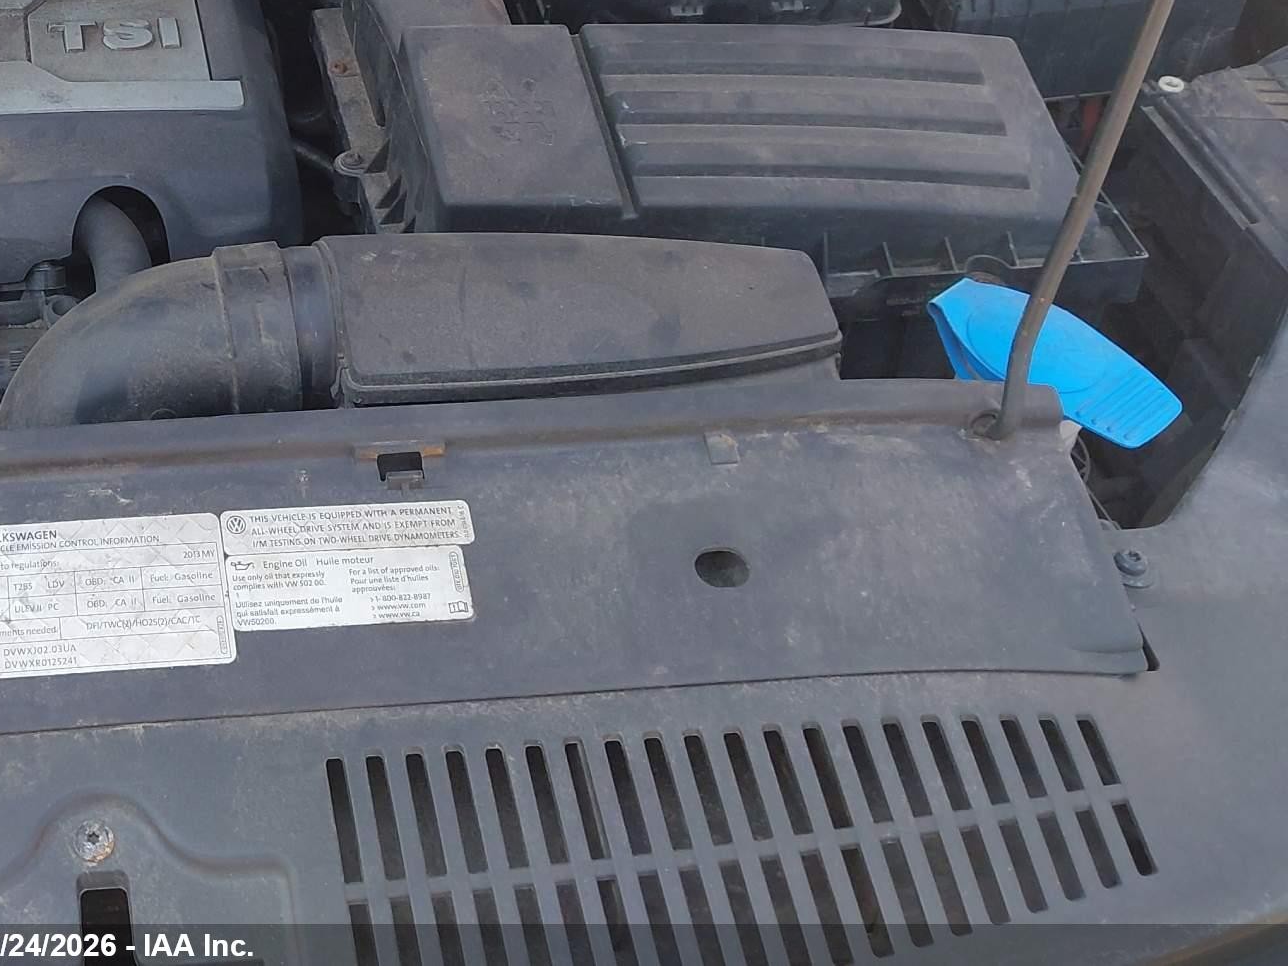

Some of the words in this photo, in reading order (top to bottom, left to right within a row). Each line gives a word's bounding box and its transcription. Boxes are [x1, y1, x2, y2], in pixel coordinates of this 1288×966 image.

[46, 17, 182, 54] TSI
[250, 514, 269, 523] THIS
[272, 513, 306, 522] VEHICLE
[309, 512, 316, 520] IS
[320, 510, 362, 520] EQUIPPED
[364, 509, 387, 518] WITH
[390, 509, 397, 517] A
[399, 507, 452, 517] PERMANENT
[252, 526, 298, 536] ALL-WHEEL
[300, 525, 324, 534] DRIVE
[328, 523, 360, 532] SYSTEM
[362, 522, 381, 530] AND
[384, 521, 392, 529] IS
[395, 520, 427, 529] EXEMPT
[431, 518, 456, 527] FROM
[16, 541, 56, 551] EMISSION
[59, 538, 97, 549] CONTROL
[100, 534, 159, 546] INFORMATION
[252, 539, 267, 549] I/M
[270, 538, 303, 547] TESTING
[304, 537, 316, 545] ON
[318, 535, 366, 545] TWO-WHEEL
[368, 533, 392, 542] DRIVE
[183, 550, 201, 559] 2013
[201, 549, 215, 558] MY
[0, 561, 9, 570] to
[11, 558, 60, 572] regulations:
[263, 559, 292, 571] Engine
[294, 558, 307, 567] Oil
[316, 557, 340, 566] Huile
[342, 555, 374, 565] moteur
[174, 571, 214, 581] Gasoline
[232, 573, 246, 581] Use
[248, 572, 263, 582] only
[264, 572, 274, 580] oil
[274, 571, 291, 579] that
[292, 569, 325, 580] expressly
[348, 568, 360, 576] For
[368, 567, 379, 575] list
[380, 566, 388, 574] of
[390, 564, 424, 575] approved
[47, 580, 65, 589] LDV
[113, 576, 125, 584] CA
[233, 581, 265, 592] complies
[267, 581, 283, 589] with
[285, 580, 298, 588] VW
[299, 579, 313, 587] 502
[350, 576, 367, 585] Pour
[384, 575, 400, 583] liste
[114, 598, 127, 607] CA
[177, 593, 215, 603] Gasoline
[235, 599, 262, 608] Utilisez
[264, 597, 308, 608] uniquement
[310, 596, 320, 604] de
[48, 603, 59, 611] PC
[236, 609, 249, 618] qui
[250, 607, 279, 616] satisfait
